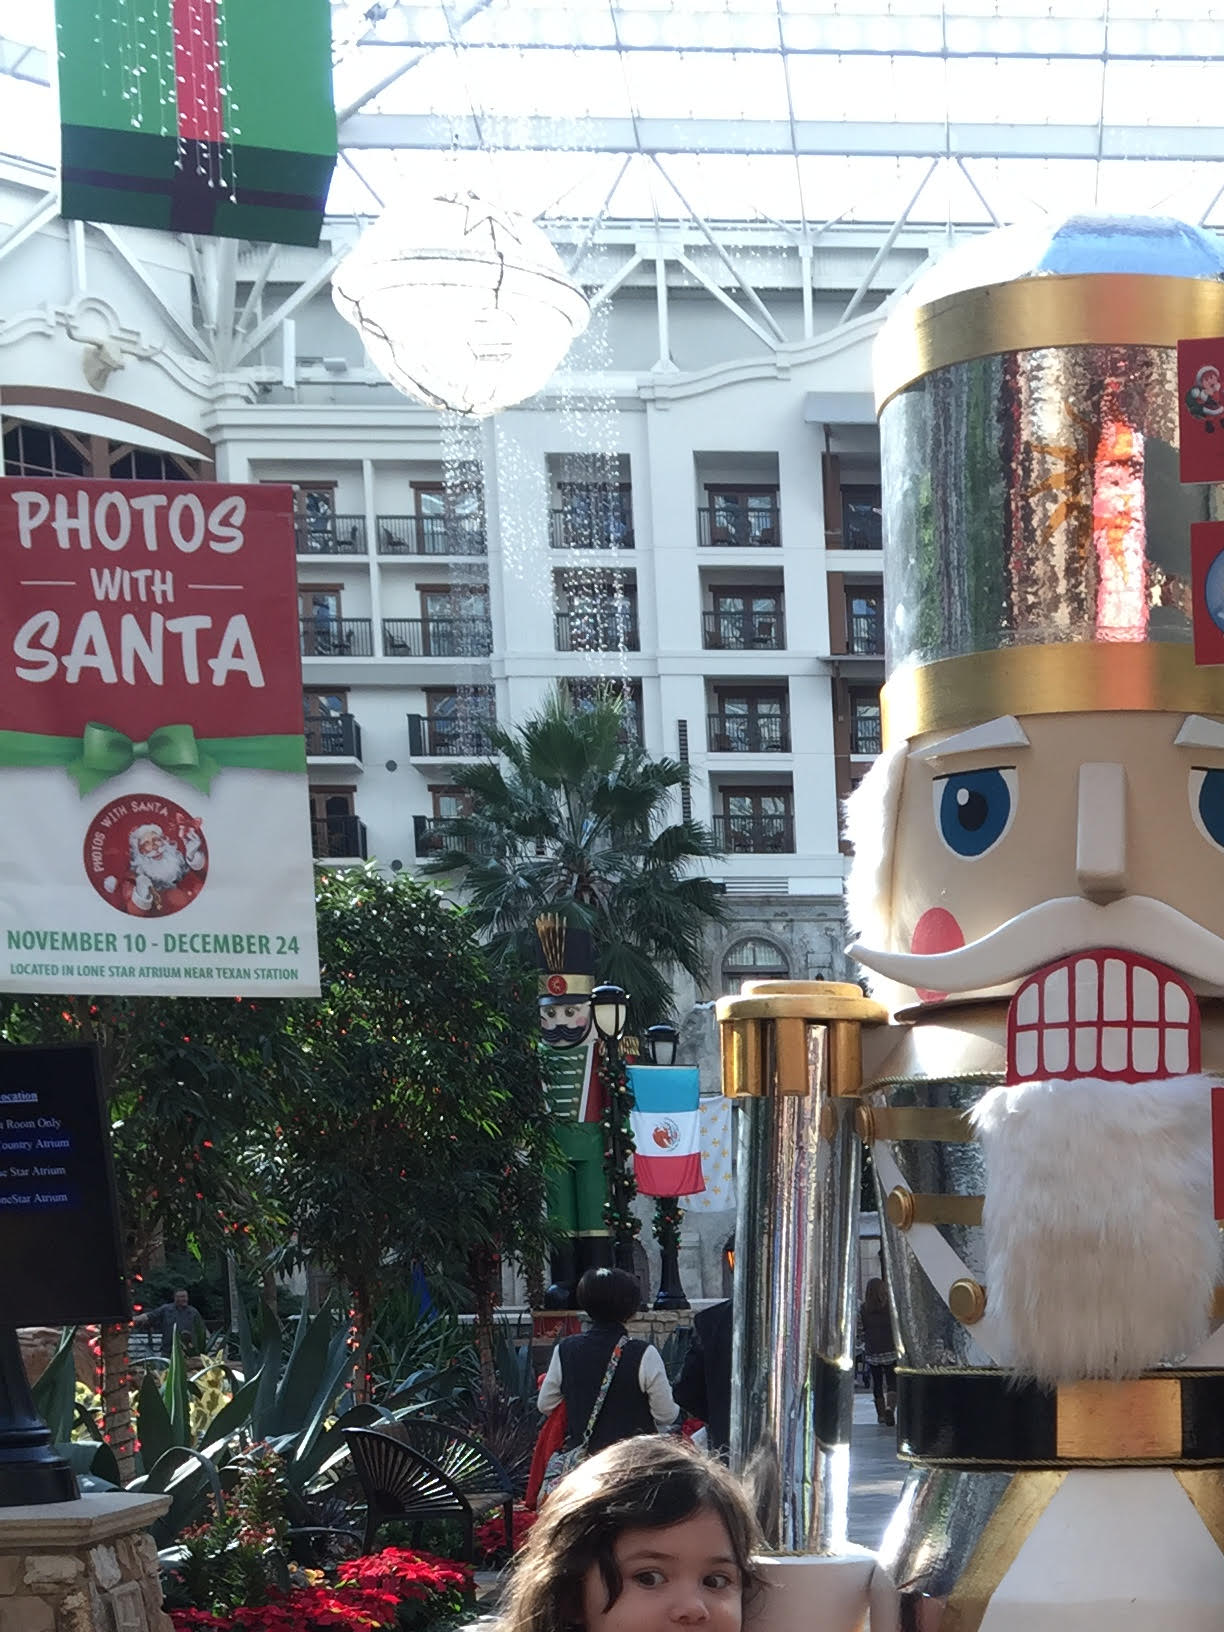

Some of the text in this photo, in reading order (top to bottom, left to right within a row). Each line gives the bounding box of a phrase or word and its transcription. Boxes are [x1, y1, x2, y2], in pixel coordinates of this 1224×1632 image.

[11, 489, 247, 554] PHOTOS
[90, 566, 175, 605] WITH
[13, 609, 266, 688] SANTA
[91, 800, 169, 873] PHOTOS WITH SANTA
[7, 930, 117, 952] NOVEMBER
[123, 933, 147, 952] 10
[163, 933, 271, 955] DECEMBER
[276, 936, 300, 955] 24
[10, 963, 298, 980] LOCATED IN LONE STAR ATRIUM NEAR TEXAN STATION
[0, 1091, 38, 1102] ocation
[0, 1140, 33, 1151] ountry
